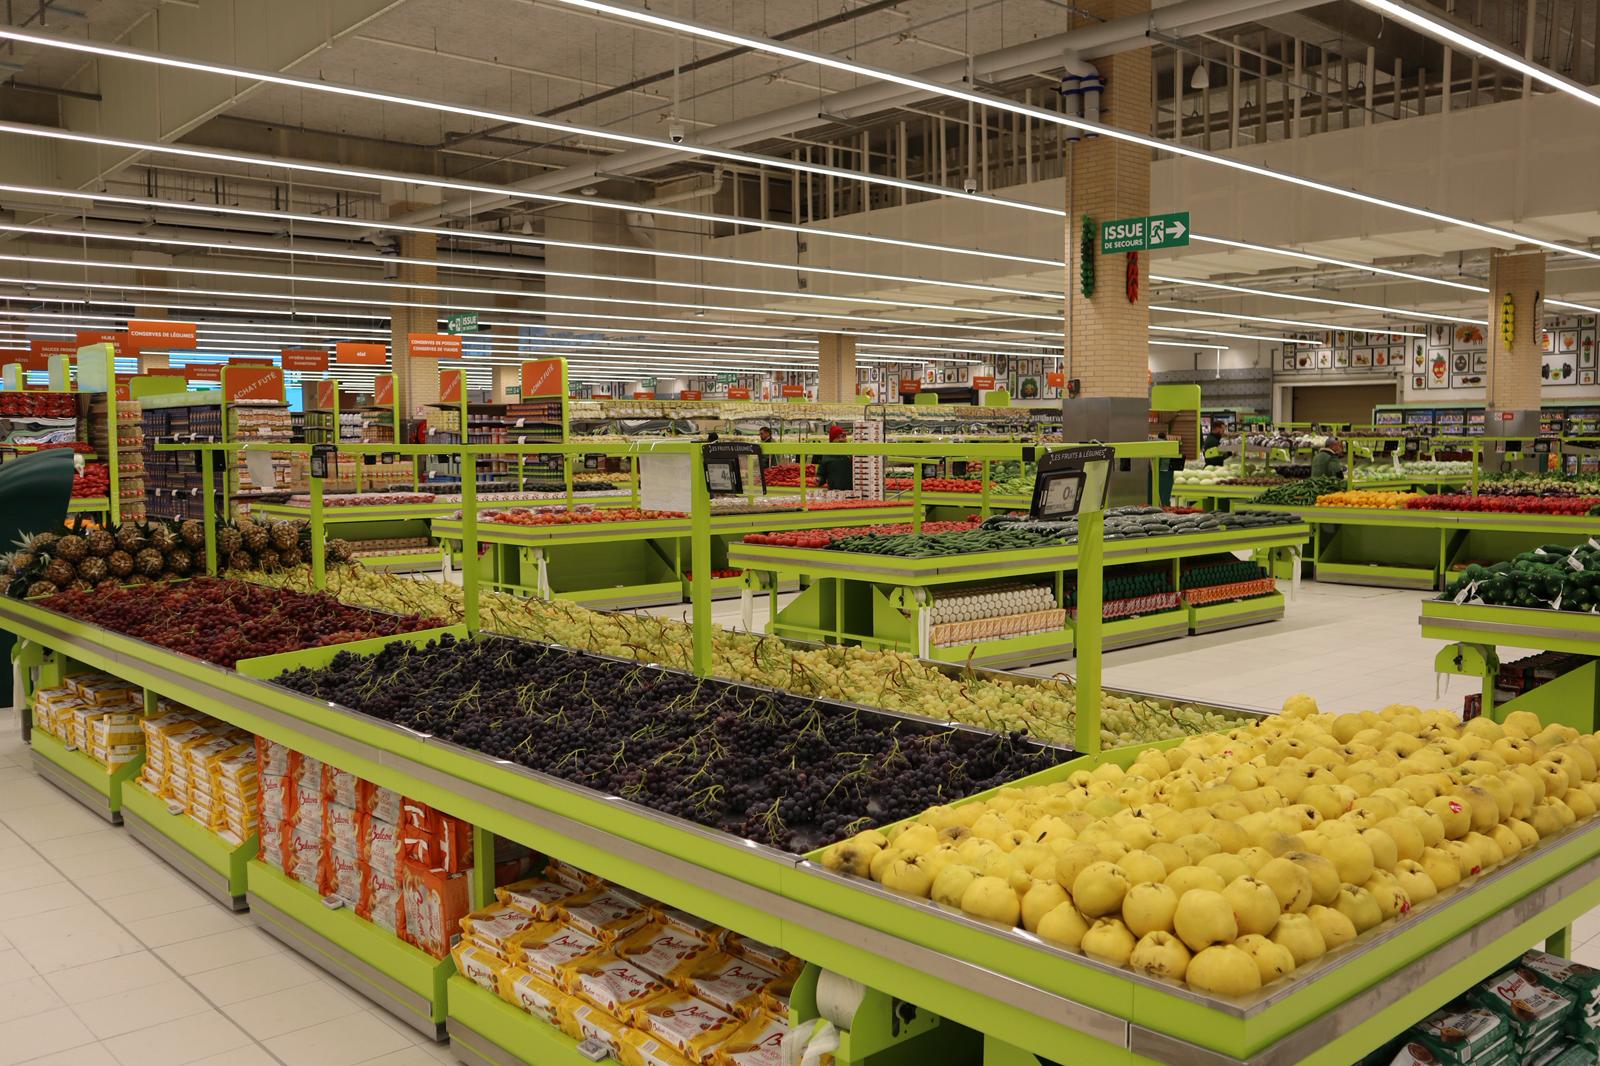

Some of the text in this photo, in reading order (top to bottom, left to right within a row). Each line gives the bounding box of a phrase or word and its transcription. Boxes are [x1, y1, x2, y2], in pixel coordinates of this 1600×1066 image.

[1104, 222, 1143, 240] ISSUE
[1114, 239, 1143, 249] SECOURS
[462, 315, 477, 325] ISSUE
[232, 382, 258, 400] ACHAT
[529, 376, 545, 395] ACHAT
[1051, 453, 1061, 461] LES
[1061, 452, 1078, 461] FRUITS
[1083, 449, 1105, 458] LÉGUMES
